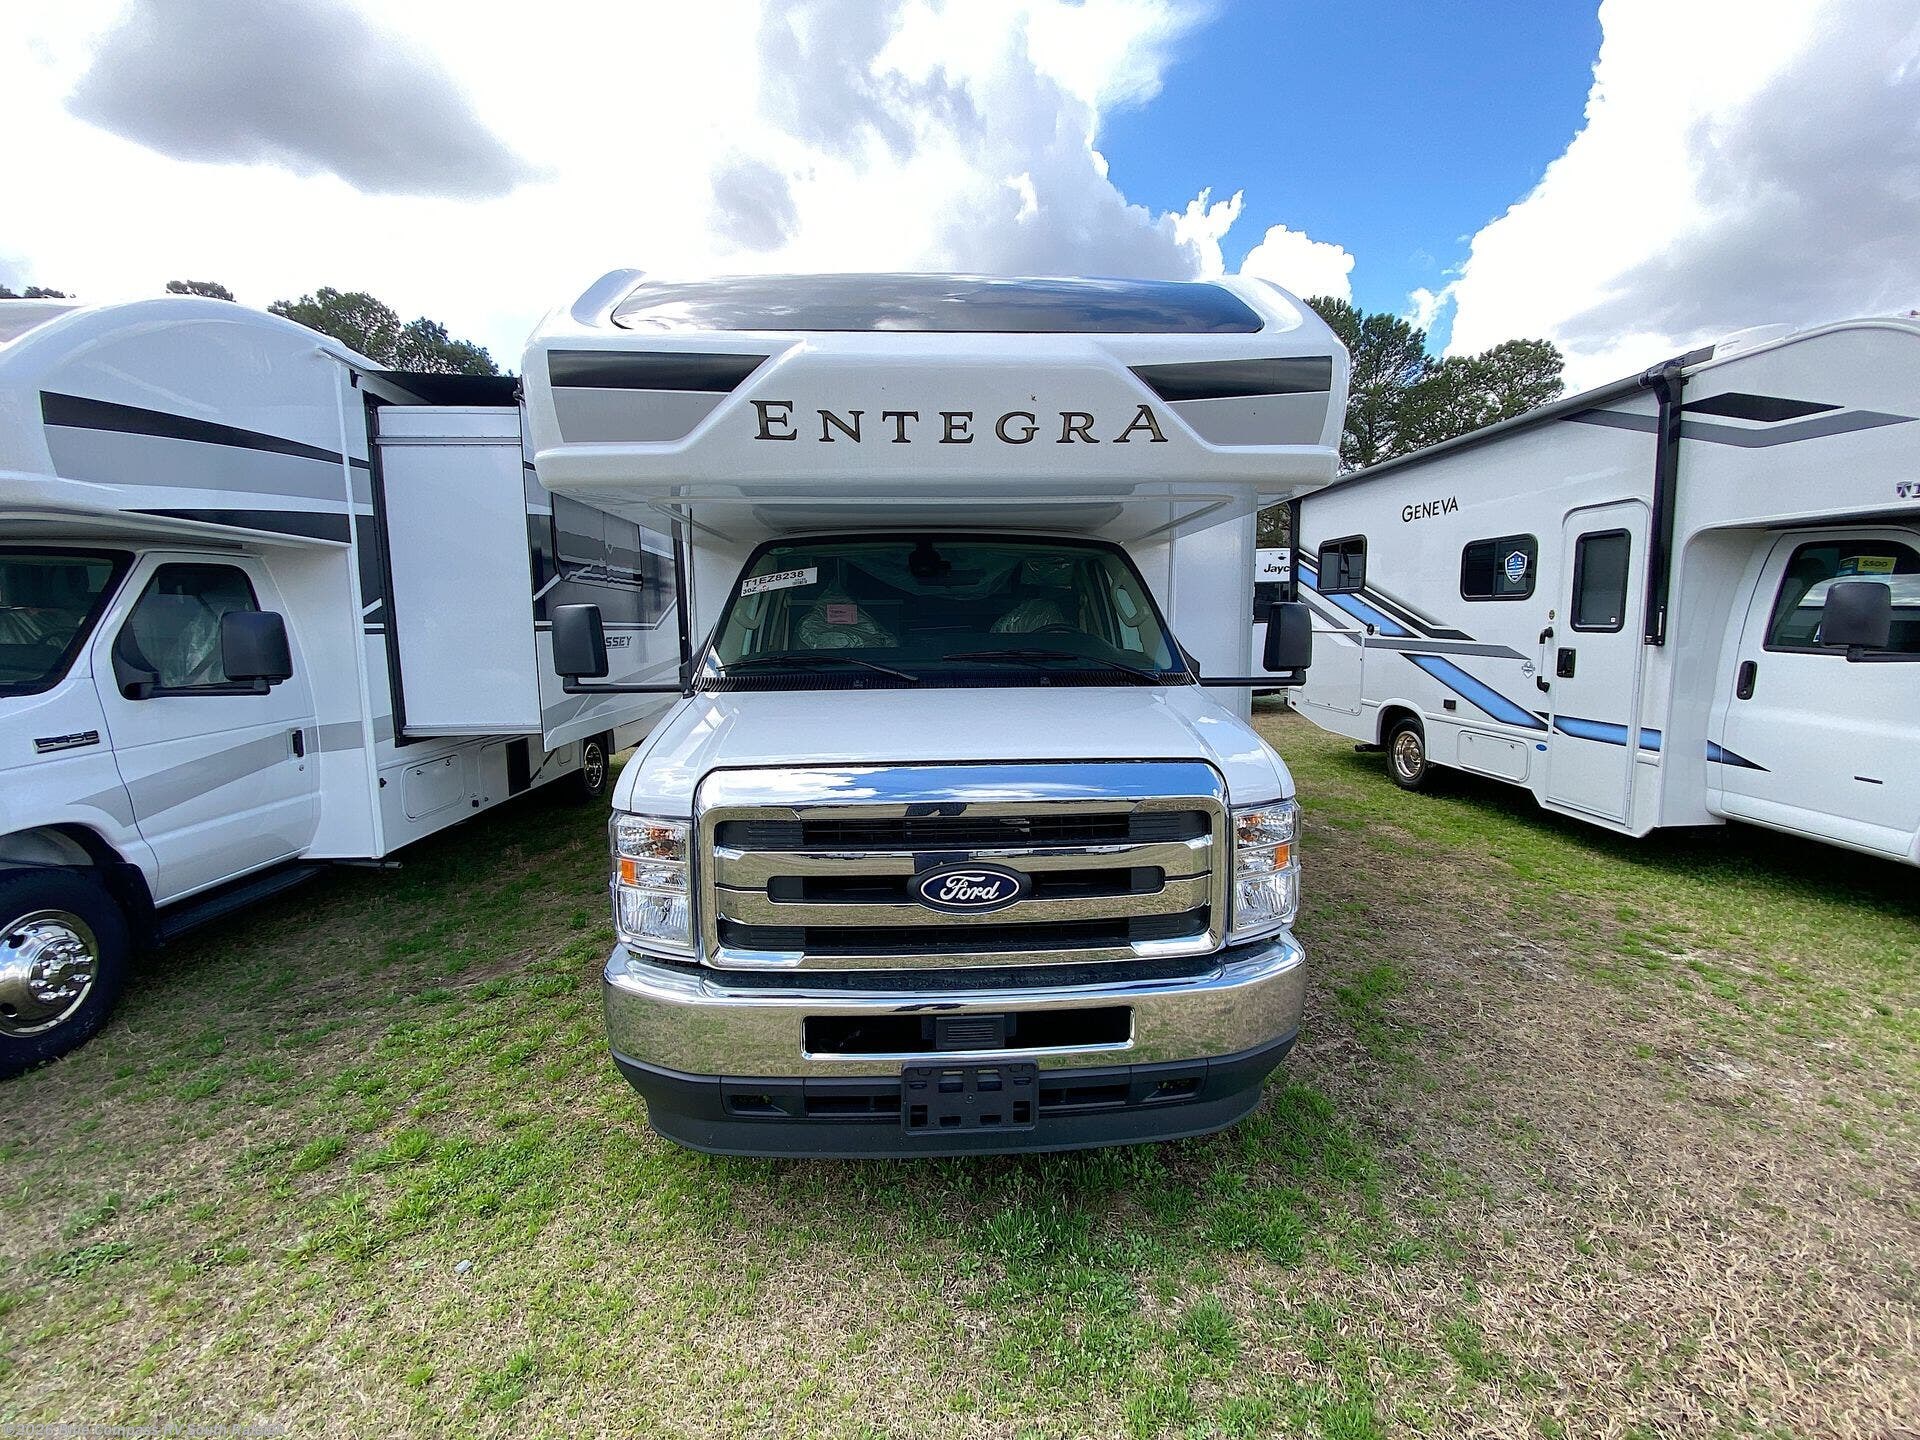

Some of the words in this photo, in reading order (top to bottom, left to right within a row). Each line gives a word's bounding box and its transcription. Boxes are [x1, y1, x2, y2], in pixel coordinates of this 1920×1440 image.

[749, 399, 1169, 444] ENTEGRA
[1401, 496, 1459, 523] GENEVA
[743, 570, 805, 588] T1EZ8238
[939, 875, 1001, 901] Ford
